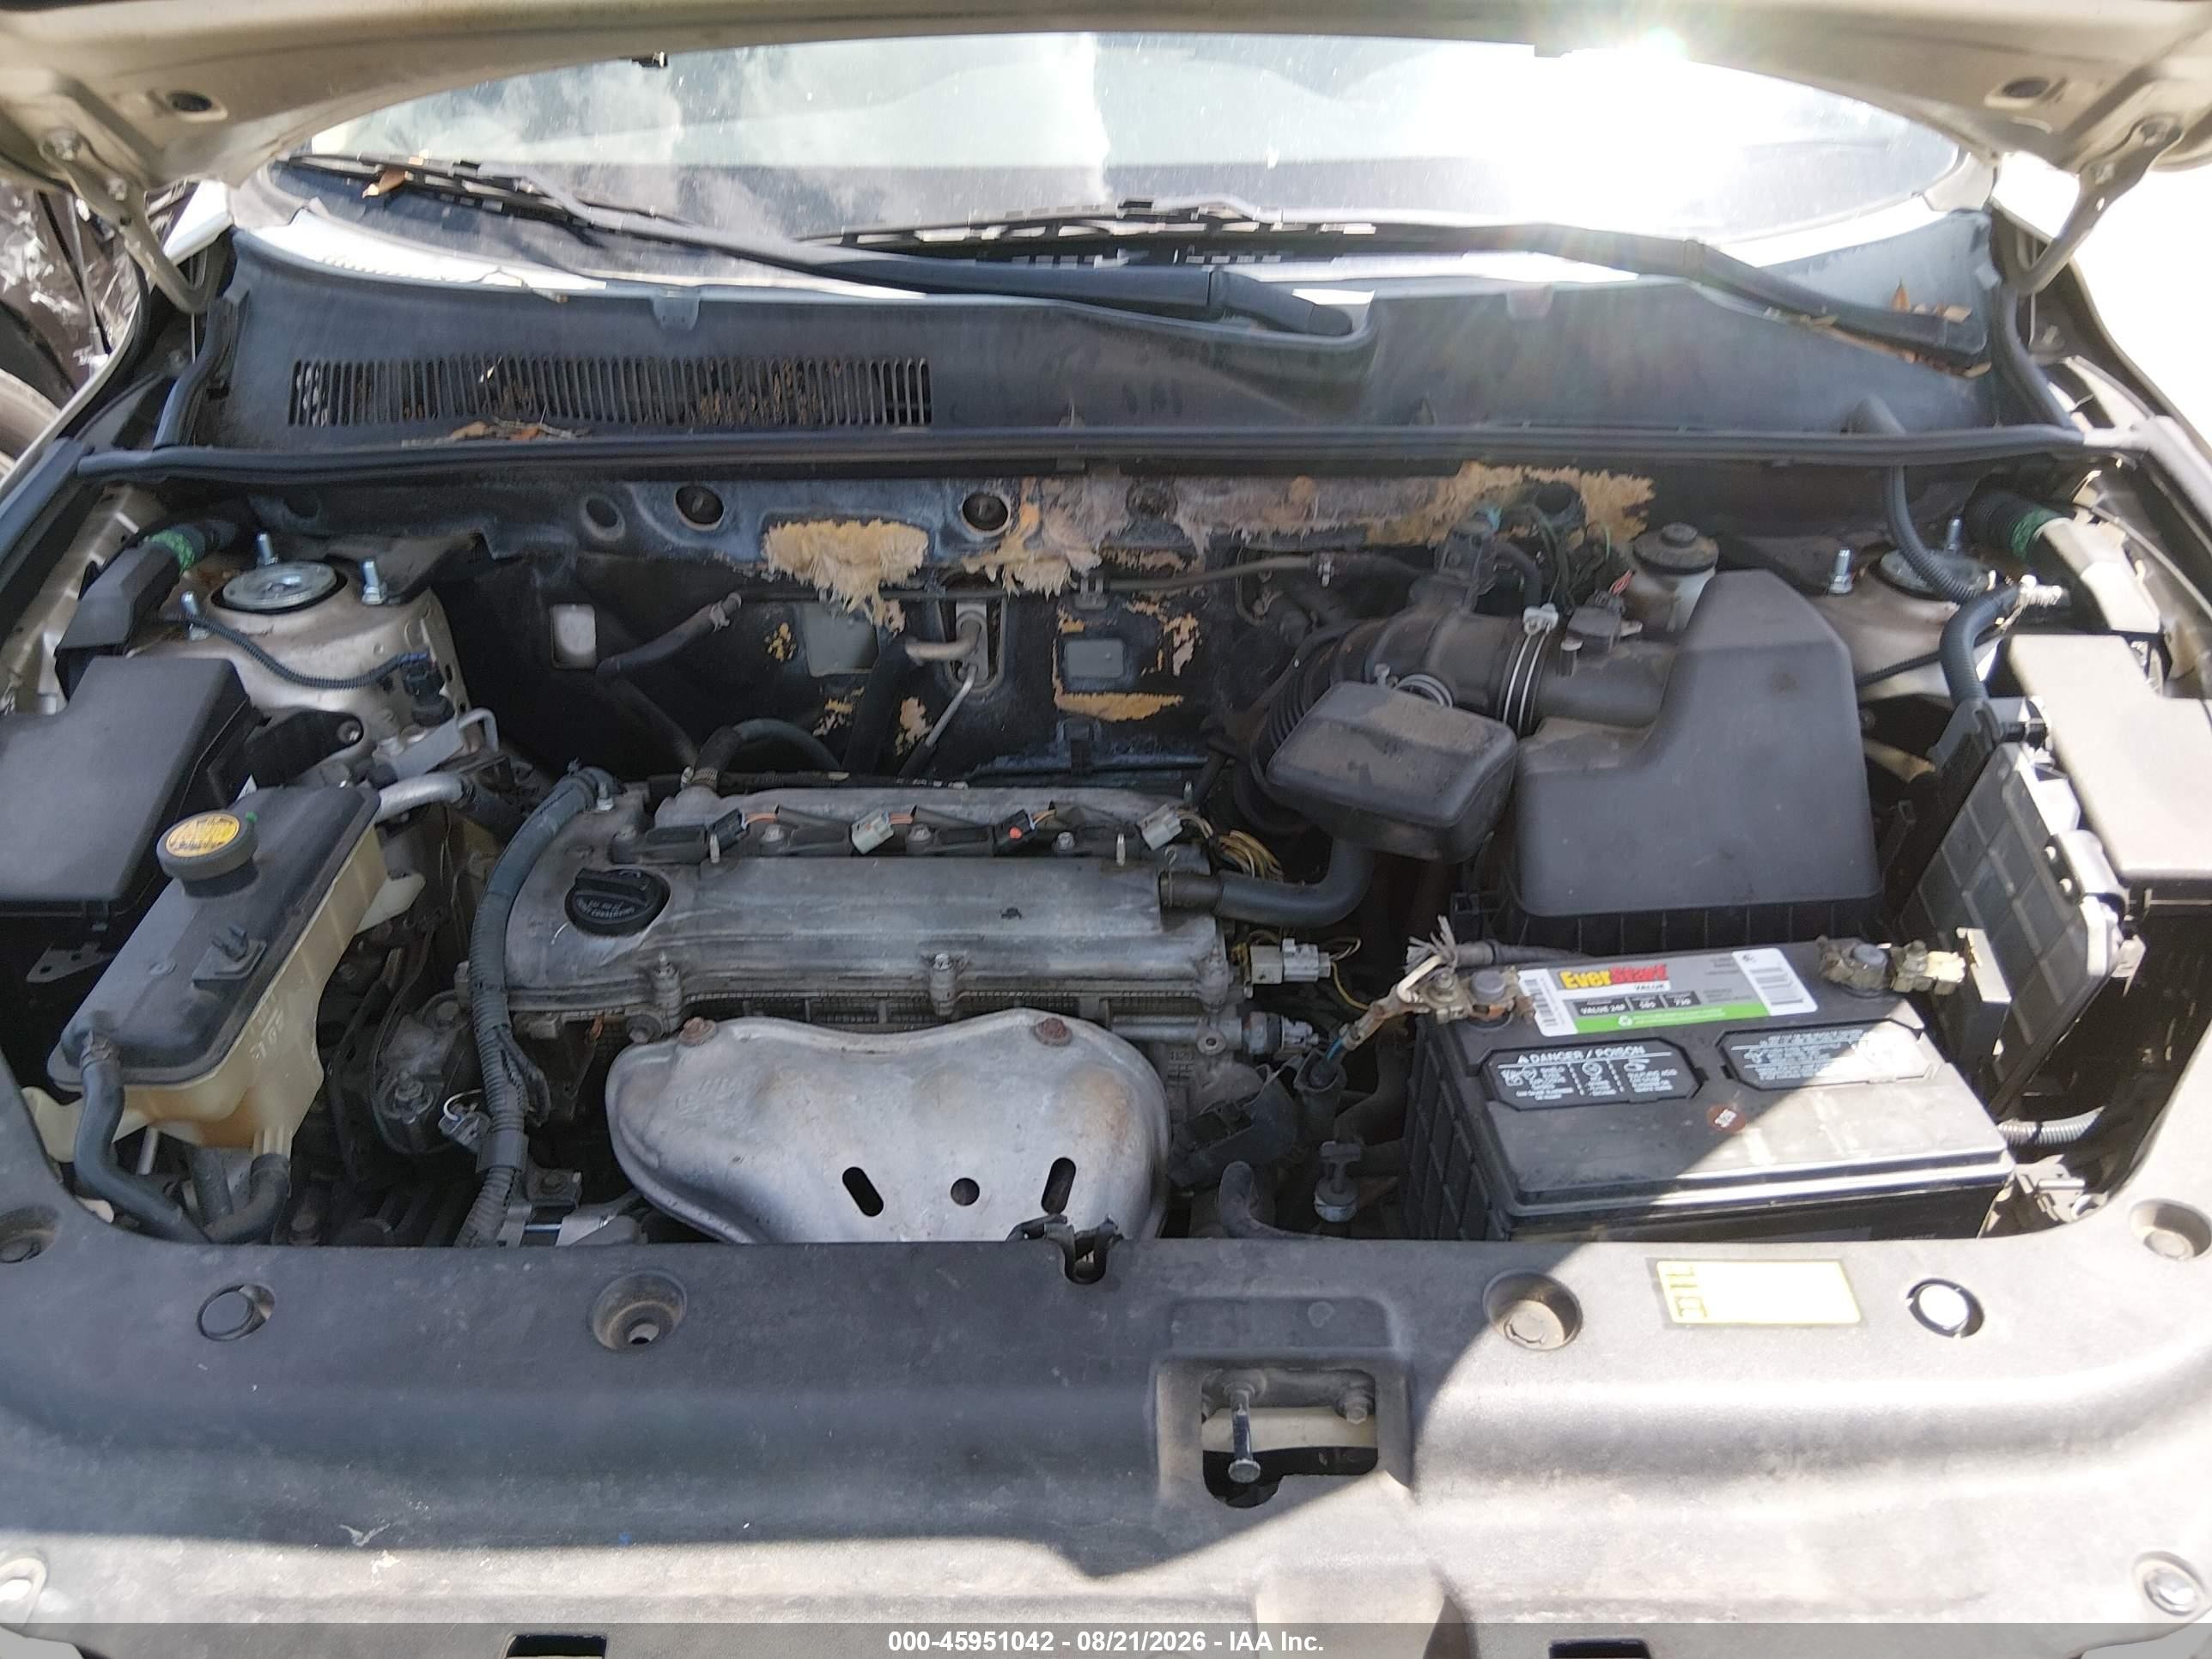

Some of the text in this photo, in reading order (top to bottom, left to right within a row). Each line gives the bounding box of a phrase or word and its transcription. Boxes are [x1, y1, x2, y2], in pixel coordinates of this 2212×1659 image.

[1559, 963, 1668, 990] EverStart
[1529, 1049, 1584, 1064] DANGER
[1595, 1045, 1646, 1058] POISON
